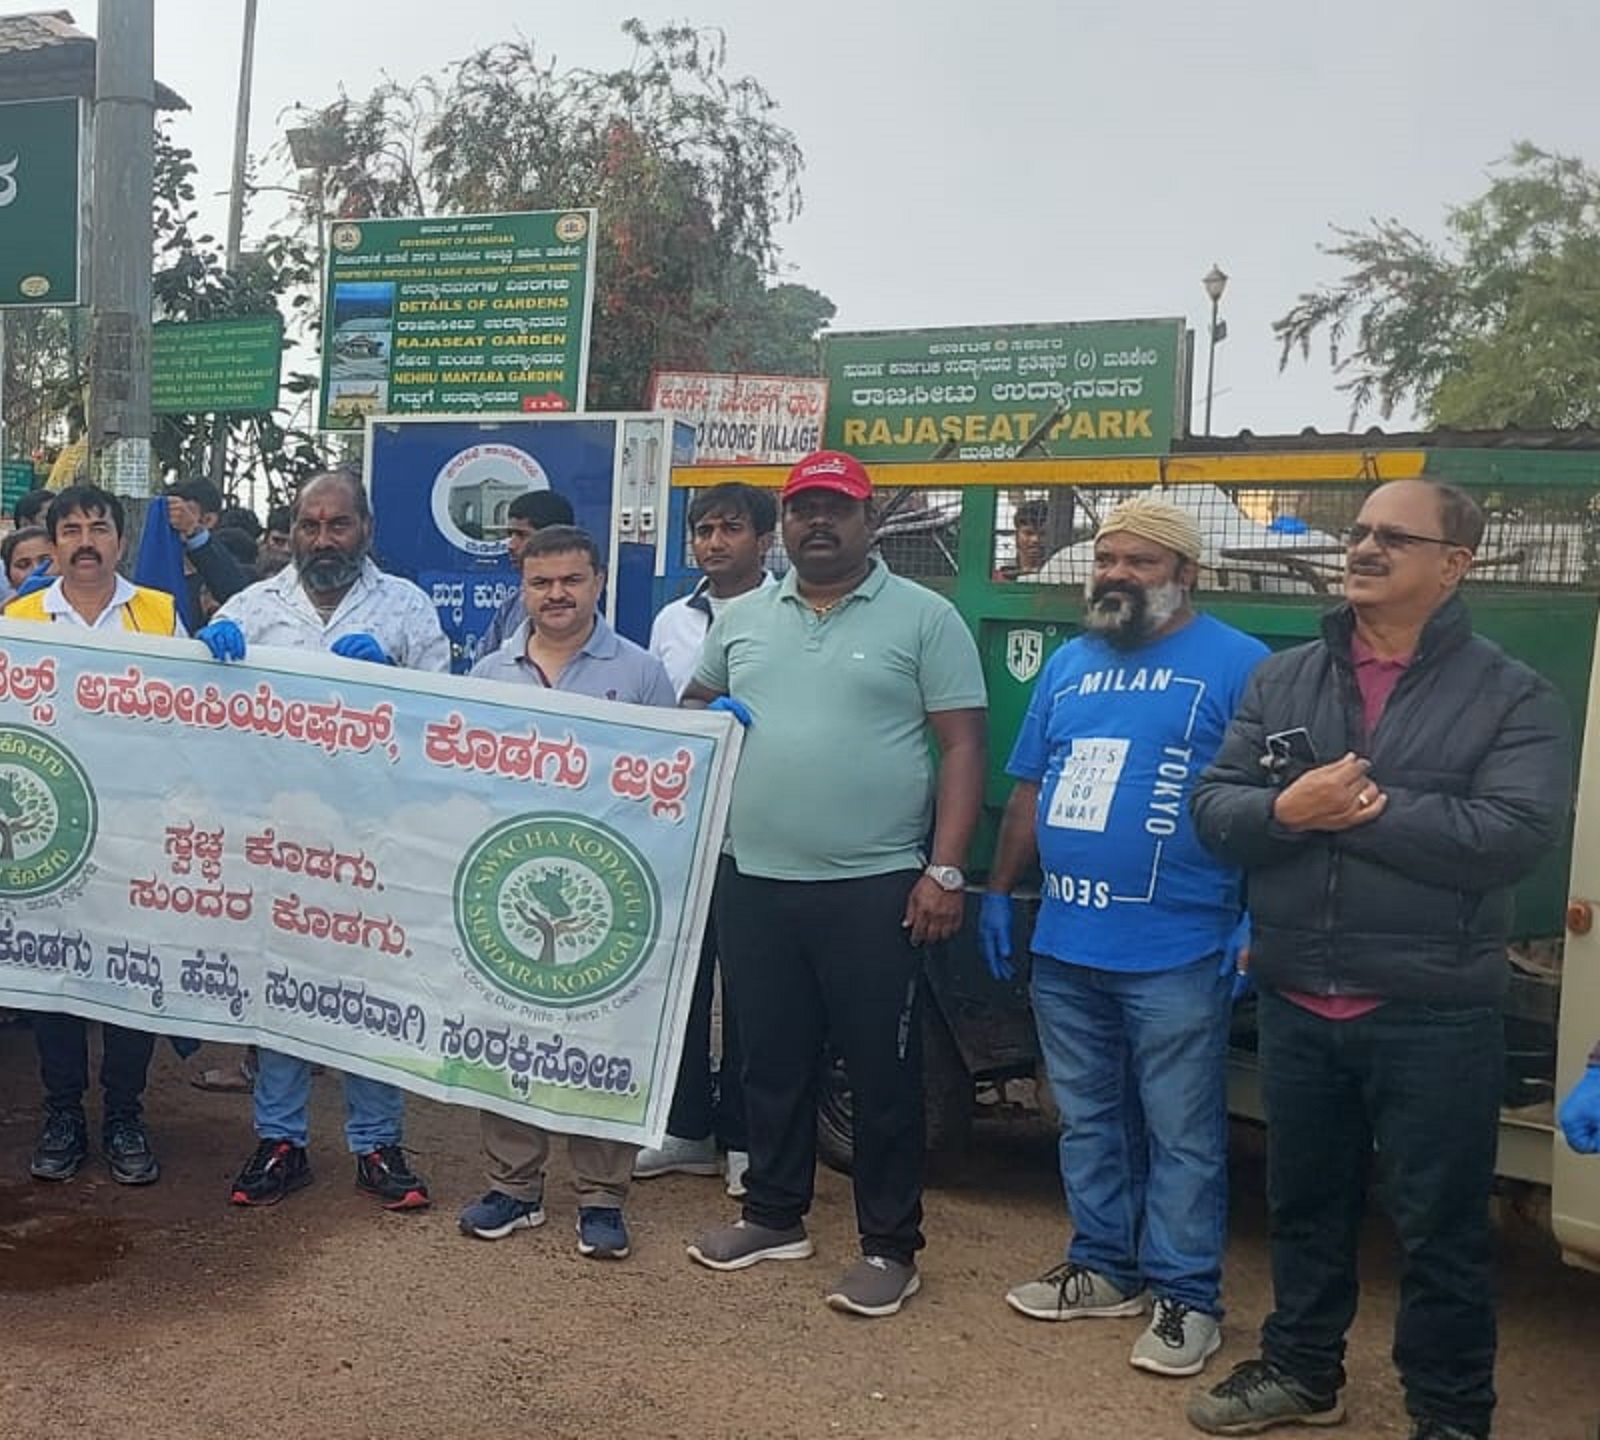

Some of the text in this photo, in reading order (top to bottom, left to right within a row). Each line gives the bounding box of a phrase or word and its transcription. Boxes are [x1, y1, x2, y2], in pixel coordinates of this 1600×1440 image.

[400, 298, 569, 312] DETAILS OF GARDENS
[396, 334, 566, 347] RAJASEAT GARDEN
[394, 372, 437, 384] NEHRU
[509, 371, 564, 382] GARDEN
[709, 423, 756, 449] COORG
[762, 425, 819, 451] VILLAGE
[843, 409, 1152, 445] RAJASEAT PARK
[1079, 669, 1173, 695] MILAN
[0, 733, 65, 777] ಕೊಡಗು
[425, 713, 588, 787] ಕೊಡಗು
[611, 750, 692, 821] ಜಿಲ್ಲೆ
[1071, 783, 1093, 800] GO
[1145, 746, 1193, 835] TOKYO
[1055, 801, 1099, 821] AWAY
[7, 848, 70, 886] ಕೊಡಗು
[164, 821, 224, 883] ಸ್ವಚ್ಛ
[245, 827, 384, 891] ಕೊಡಗು.
[476, 831, 642, 913] SWACHA KODAGU
[1045, 873, 1110, 909] SEOU
[129, 872, 253, 921] ಸುಂದರ
[272, 893, 413, 958] ಕೊಡಗು.
[469, 905, 636, 994] SUNDARA KODAGU
[107, 940, 164, 1008] ನಮ್ಮ
[265, 966, 426, 1044] ಸುಂದರವಾಗಿ
[495, 994, 516, 1011] Our
[519, 1004, 554, 1023] Pride
[566, 1007, 600, 1024] Keep
